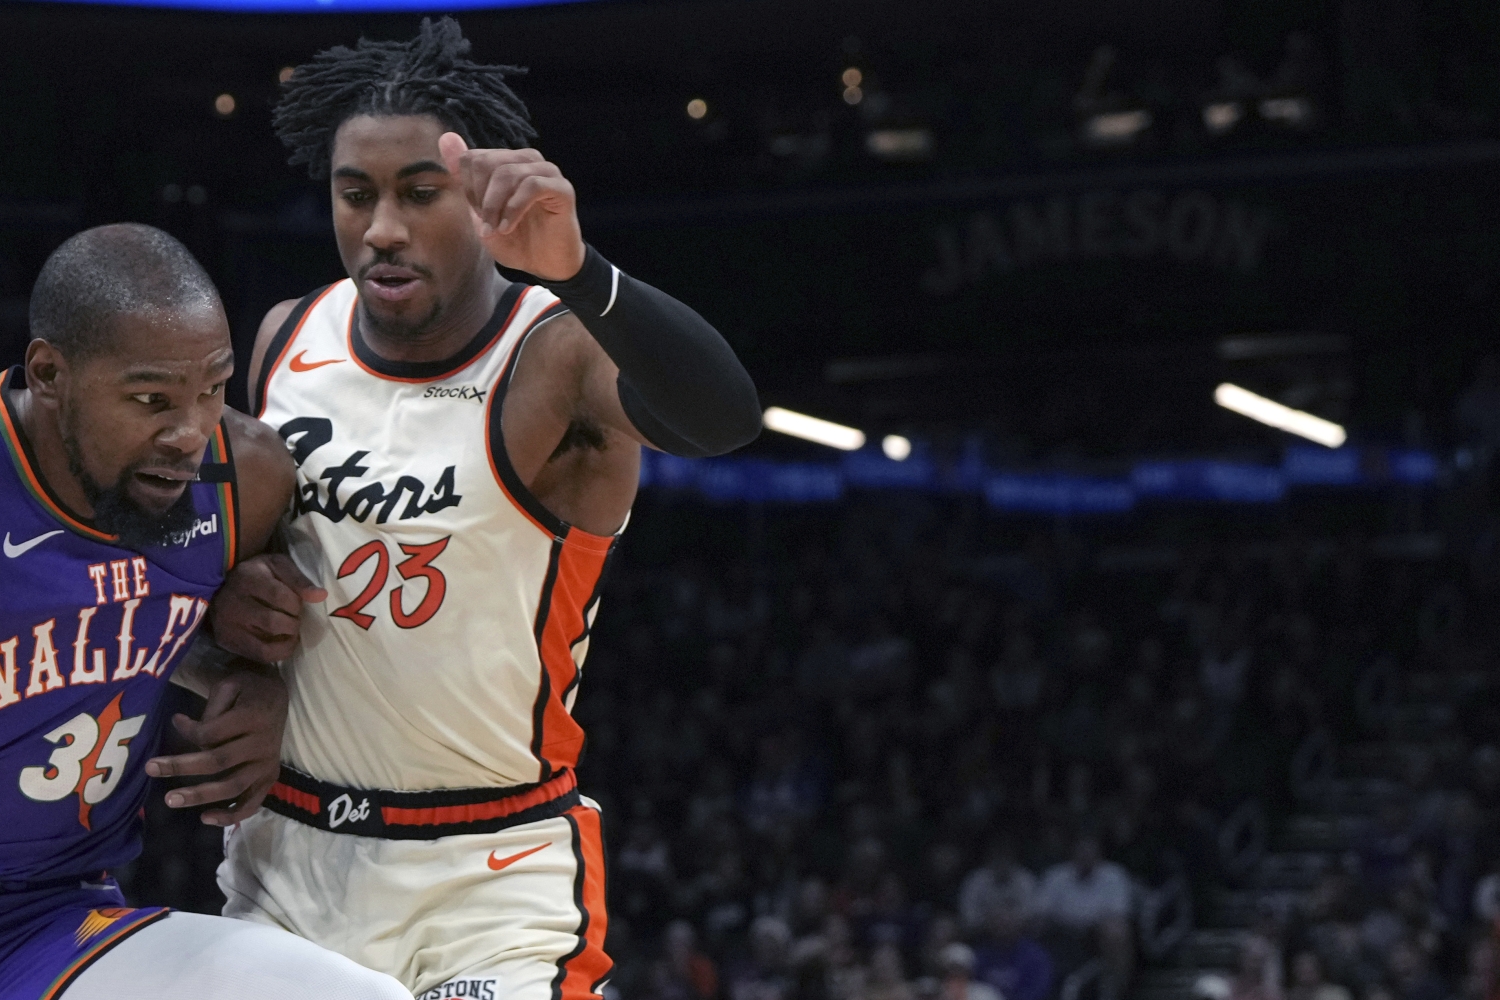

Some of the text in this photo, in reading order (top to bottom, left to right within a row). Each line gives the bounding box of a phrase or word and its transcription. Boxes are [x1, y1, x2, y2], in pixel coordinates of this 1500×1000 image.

[918, 190, 1282, 296] JAMESON
[423, 386, 487, 404] StockX
[88, 556, 149, 604] THE
[329, 535, 452, 631] 23
[19, 712, 146, 804] 35
[327, 793, 370, 829] Det
